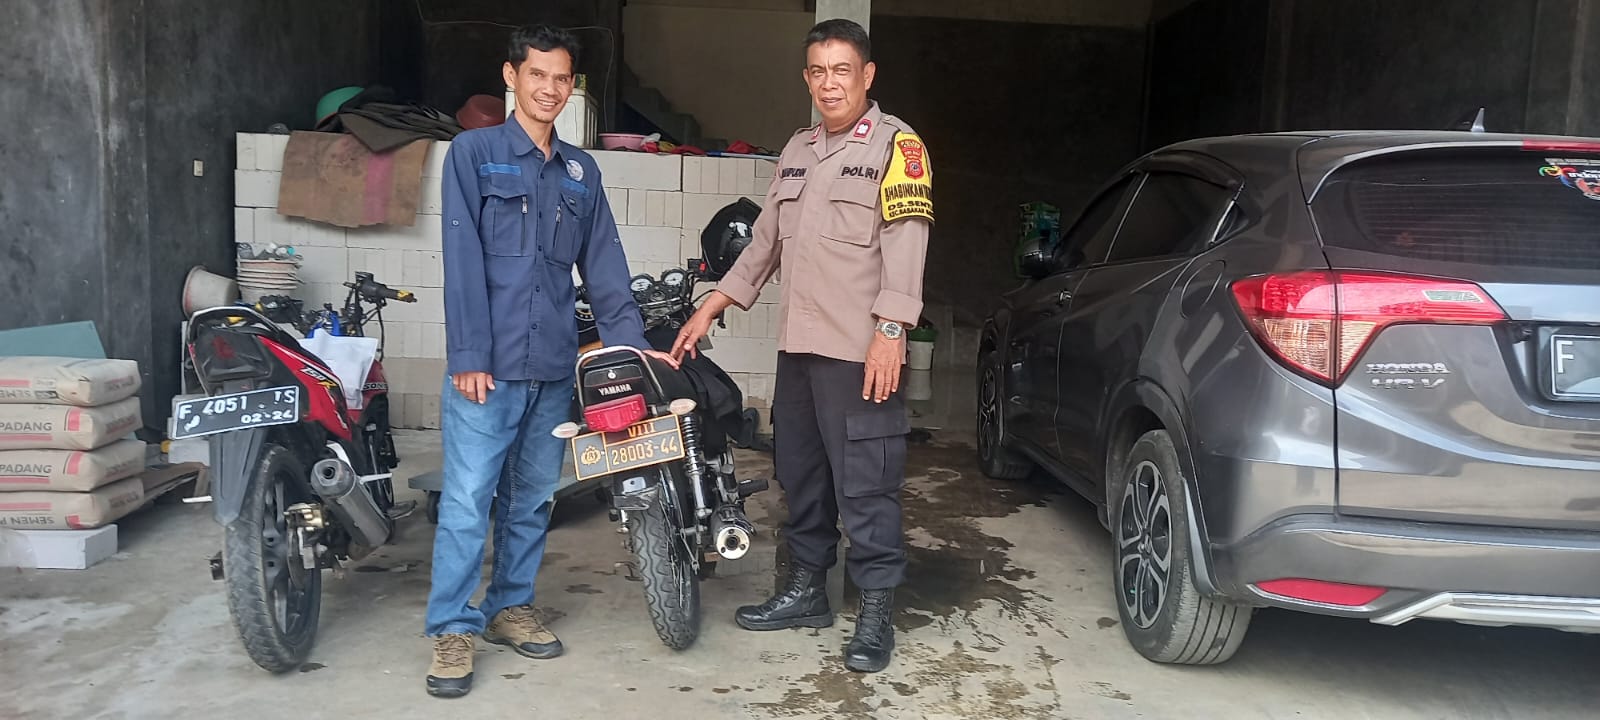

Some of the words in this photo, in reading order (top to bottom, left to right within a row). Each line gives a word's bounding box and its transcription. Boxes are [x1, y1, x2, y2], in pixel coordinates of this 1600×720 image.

[841, 166, 879, 180] POLRI
[1556, 341, 1574, 373] F
[1366, 362, 1450, 374] HONDA
[598, 383, 632, 396] YAMAHA
[180, 404, 192, 419] F
[202, 396, 248, 416] 4051
[241, 409, 293, 424] 02-24
[612, 436, 678, 465] 28003-44
[11, 516, 55, 525] SEMEN
